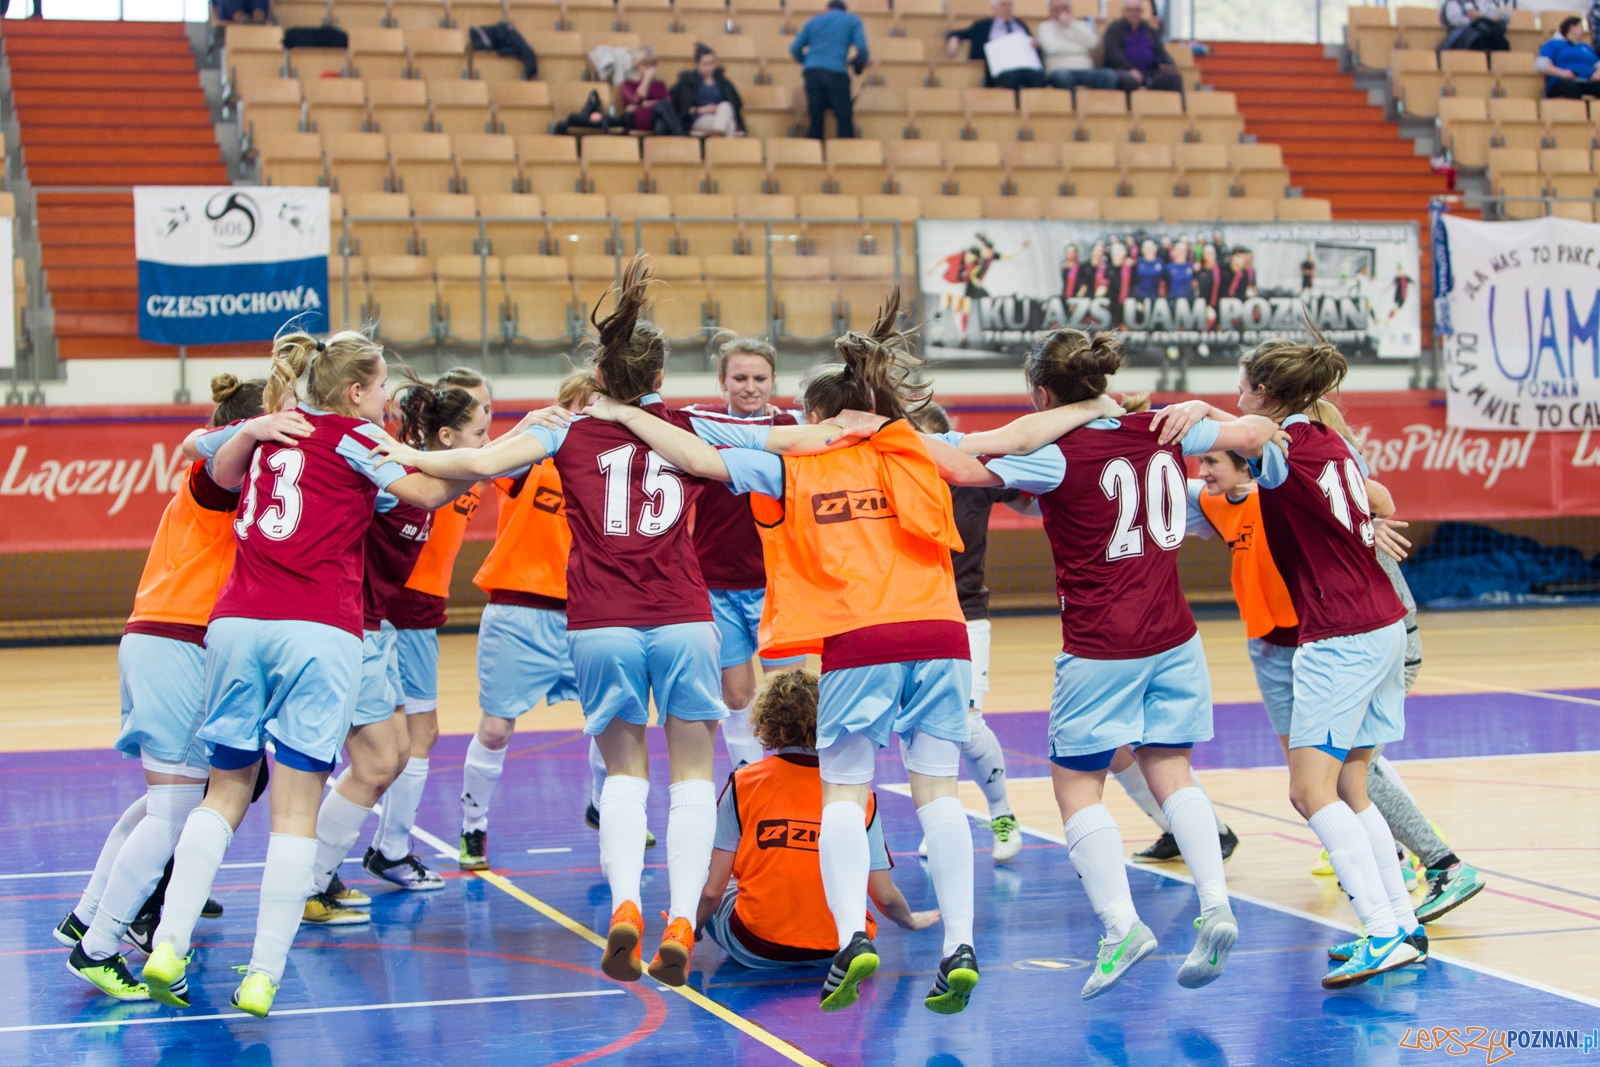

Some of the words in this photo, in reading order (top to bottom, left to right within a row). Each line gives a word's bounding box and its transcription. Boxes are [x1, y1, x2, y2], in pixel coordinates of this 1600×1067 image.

[1530, 245, 1551, 263] TO
[146, 285, 322, 318] CZESTOCHOWA
[979, 296, 1031, 331] KU
[1041, 296, 1113, 332] AZS
[1122, 296, 1207, 331] UAM
[1488, 284, 1600, 380] UAM
[1535, 402, 1563, 427] TO
[1361, 424, 1537, 489] asPilka.pl
[597, 443, 685, 537] 15
[1098, 450, 1188, 562] 20
[1316, 457, 1375, 548] 19
